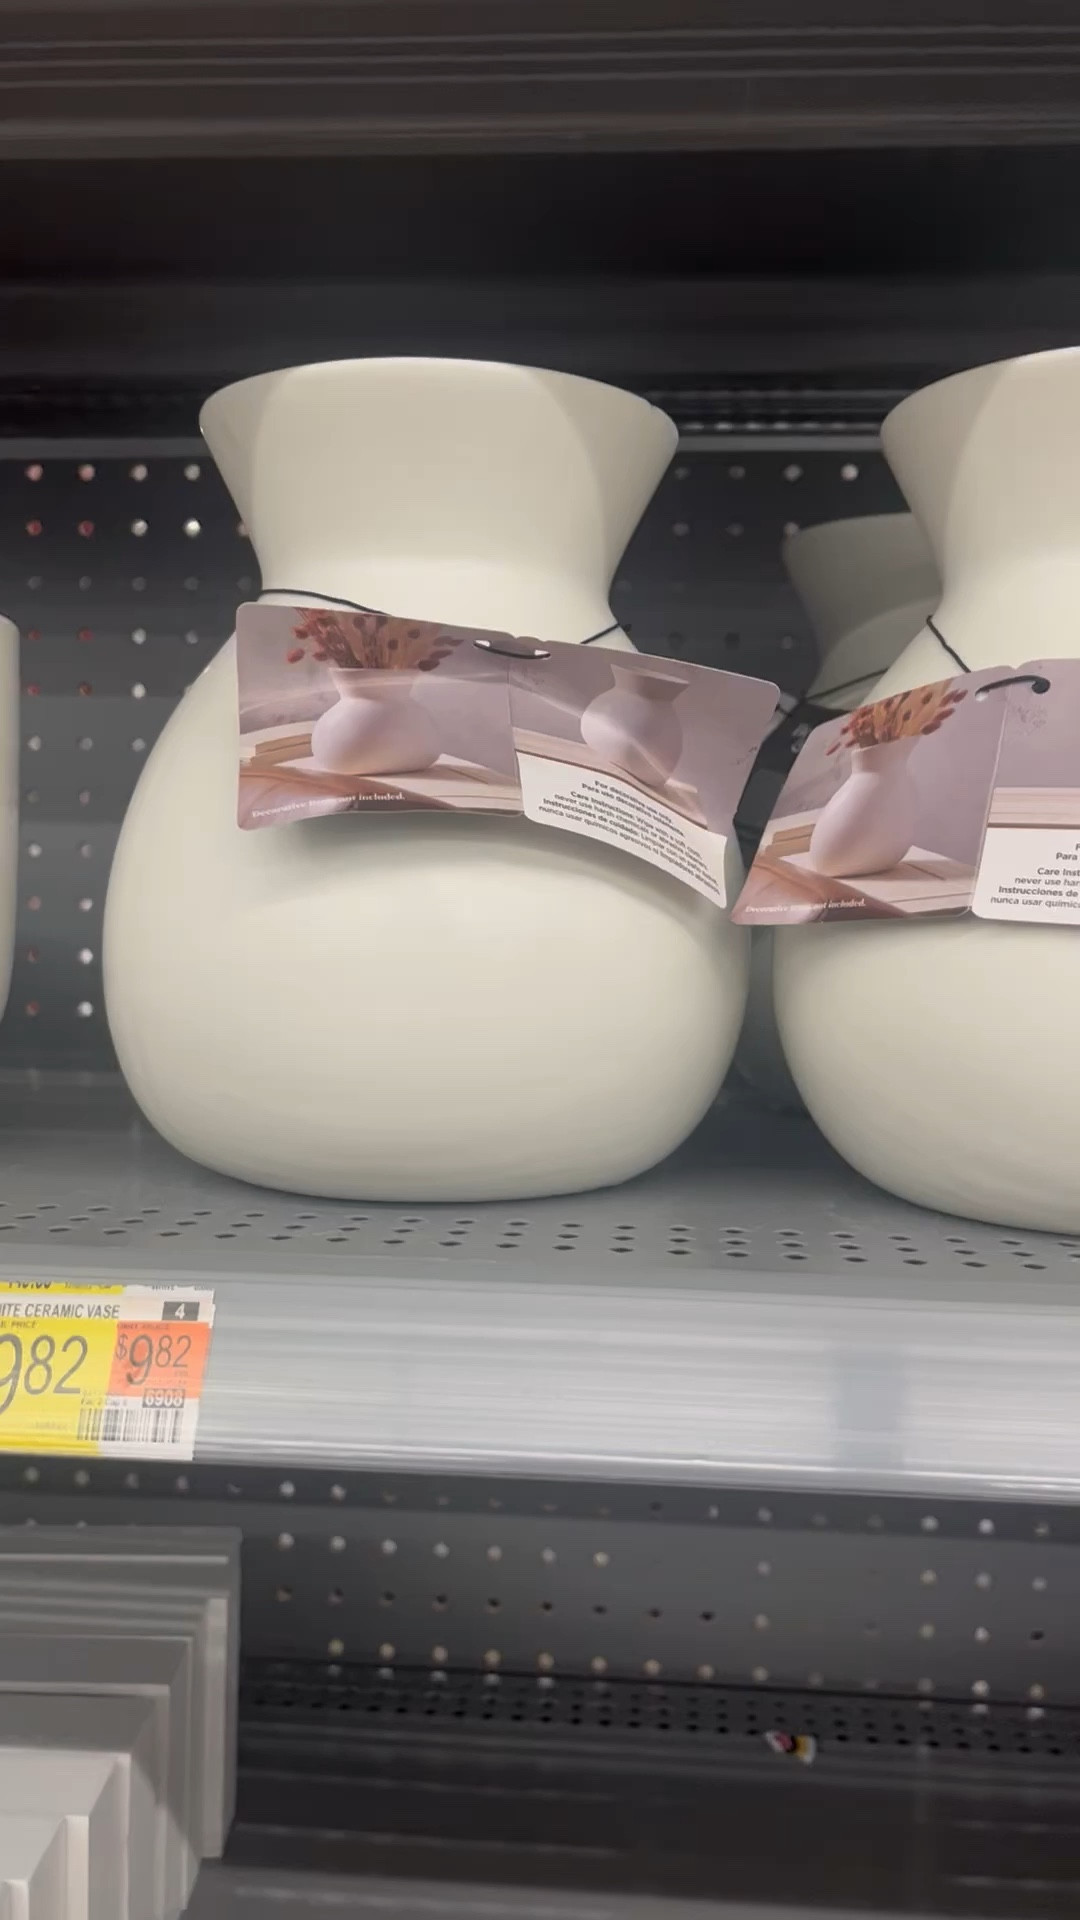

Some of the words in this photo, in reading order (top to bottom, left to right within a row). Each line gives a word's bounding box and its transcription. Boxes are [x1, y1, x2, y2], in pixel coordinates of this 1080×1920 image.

[582, 783, 600, 793] Para
[570, 791, 589, 801] Care
[543, 798, 596, 819] Instrucciones
[598, 815, 608, 823] de
[554, 794, 577, 804] never
[579, 801, 593, 810] use
[594, 805, 615, 818] harsh
[538, 806, 564, 817] nunca
[565, 813, 582, 821] usar
[1056, 851, 1078, 860] Para
[1037, 867, 1060, 876] Care
[1014, 877, 1041, 885] never
[998, 886, 1063, 897] Instrucciones
[1065, 889, 1078, 898] de
[990, 896, 1020, 905] nunca
[1021, 898, 1043, 907] usar
[0, 1303, 22, 1318] ITE
[24, 1303, 84, 1319] CERAMIC
[87, 1304, 120, 1320] VASE
[174, 1303, 186, 1320] 4
